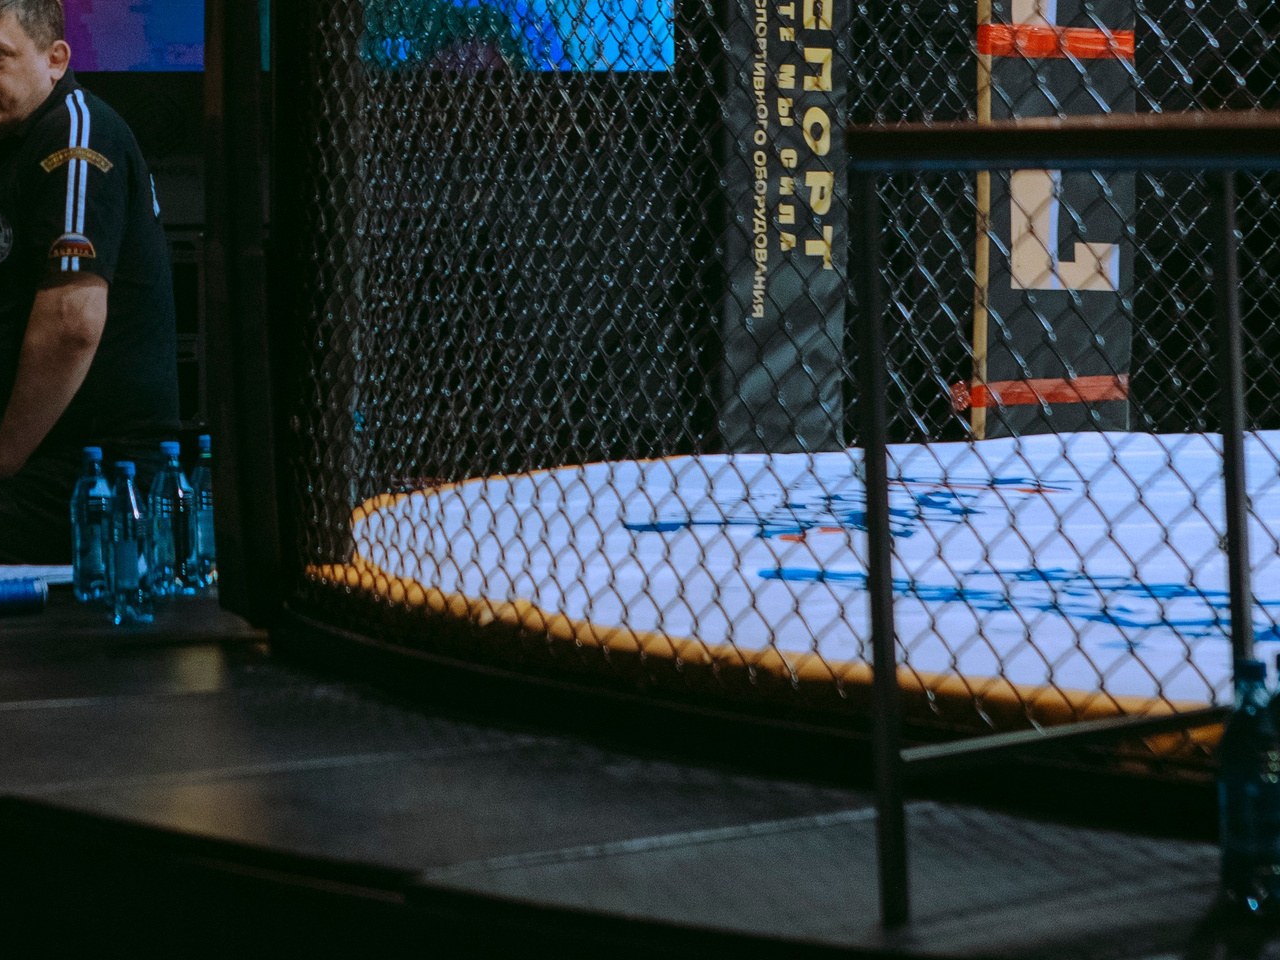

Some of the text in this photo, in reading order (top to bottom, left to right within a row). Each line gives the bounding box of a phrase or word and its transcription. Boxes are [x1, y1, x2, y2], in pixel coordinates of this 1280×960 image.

[777, 64, 796, 127] МЫ
[752, 150, 766, 319] ОБОРУДОВАНИЯ
[778, 148, 797, 252] СИЛА
